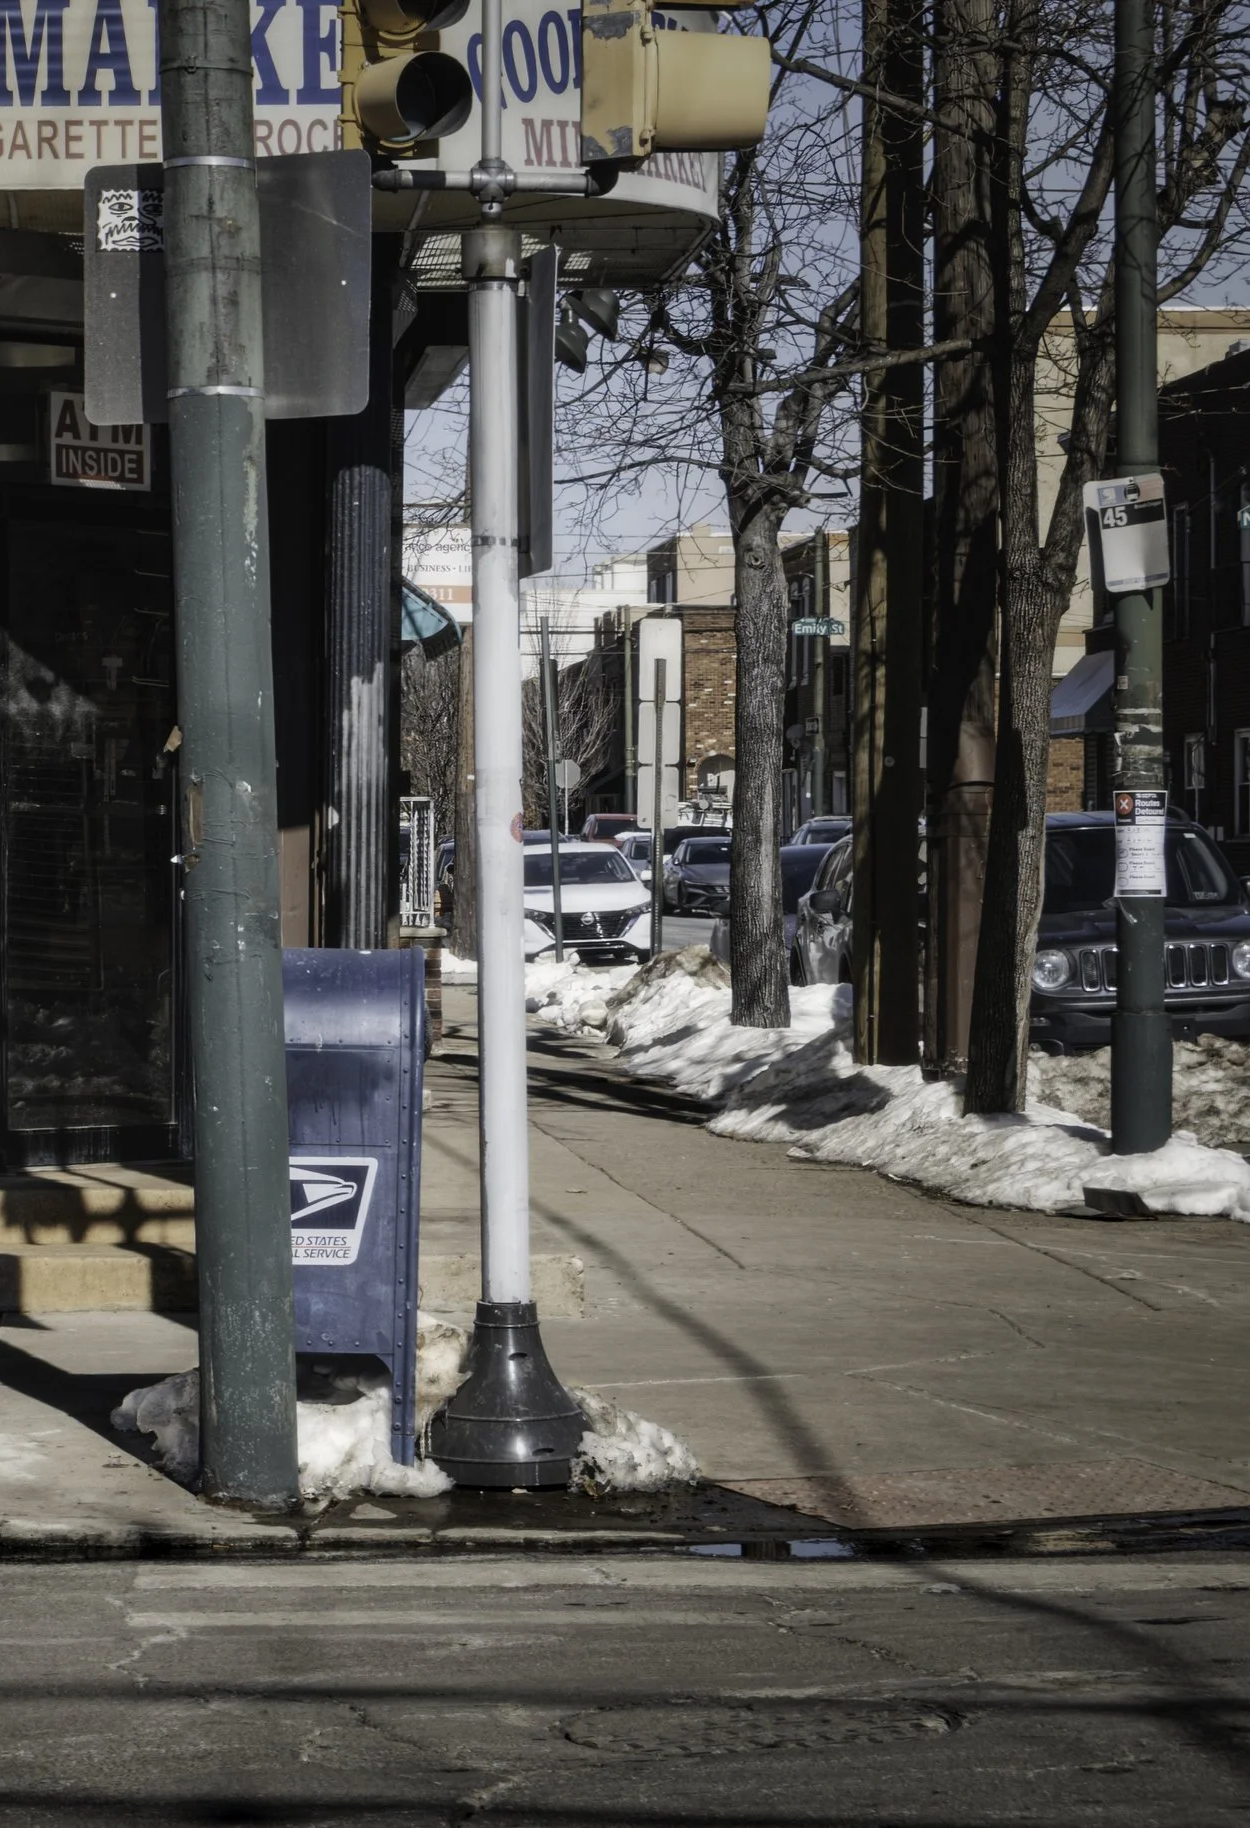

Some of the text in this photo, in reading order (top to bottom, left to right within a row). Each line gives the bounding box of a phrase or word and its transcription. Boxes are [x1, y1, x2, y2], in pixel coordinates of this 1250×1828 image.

[637, 151, 707, 194] ARKET
[62, 448, 138, 479] INSIDE
[1103, 506, 1128, 527] 45
[436, 543, 471, 554] agenc
[794, 623, 843, 636] Emily St
[306, 1236, 347, 1246] STATES
[303, 1249, 350, 1258] SERVICE
